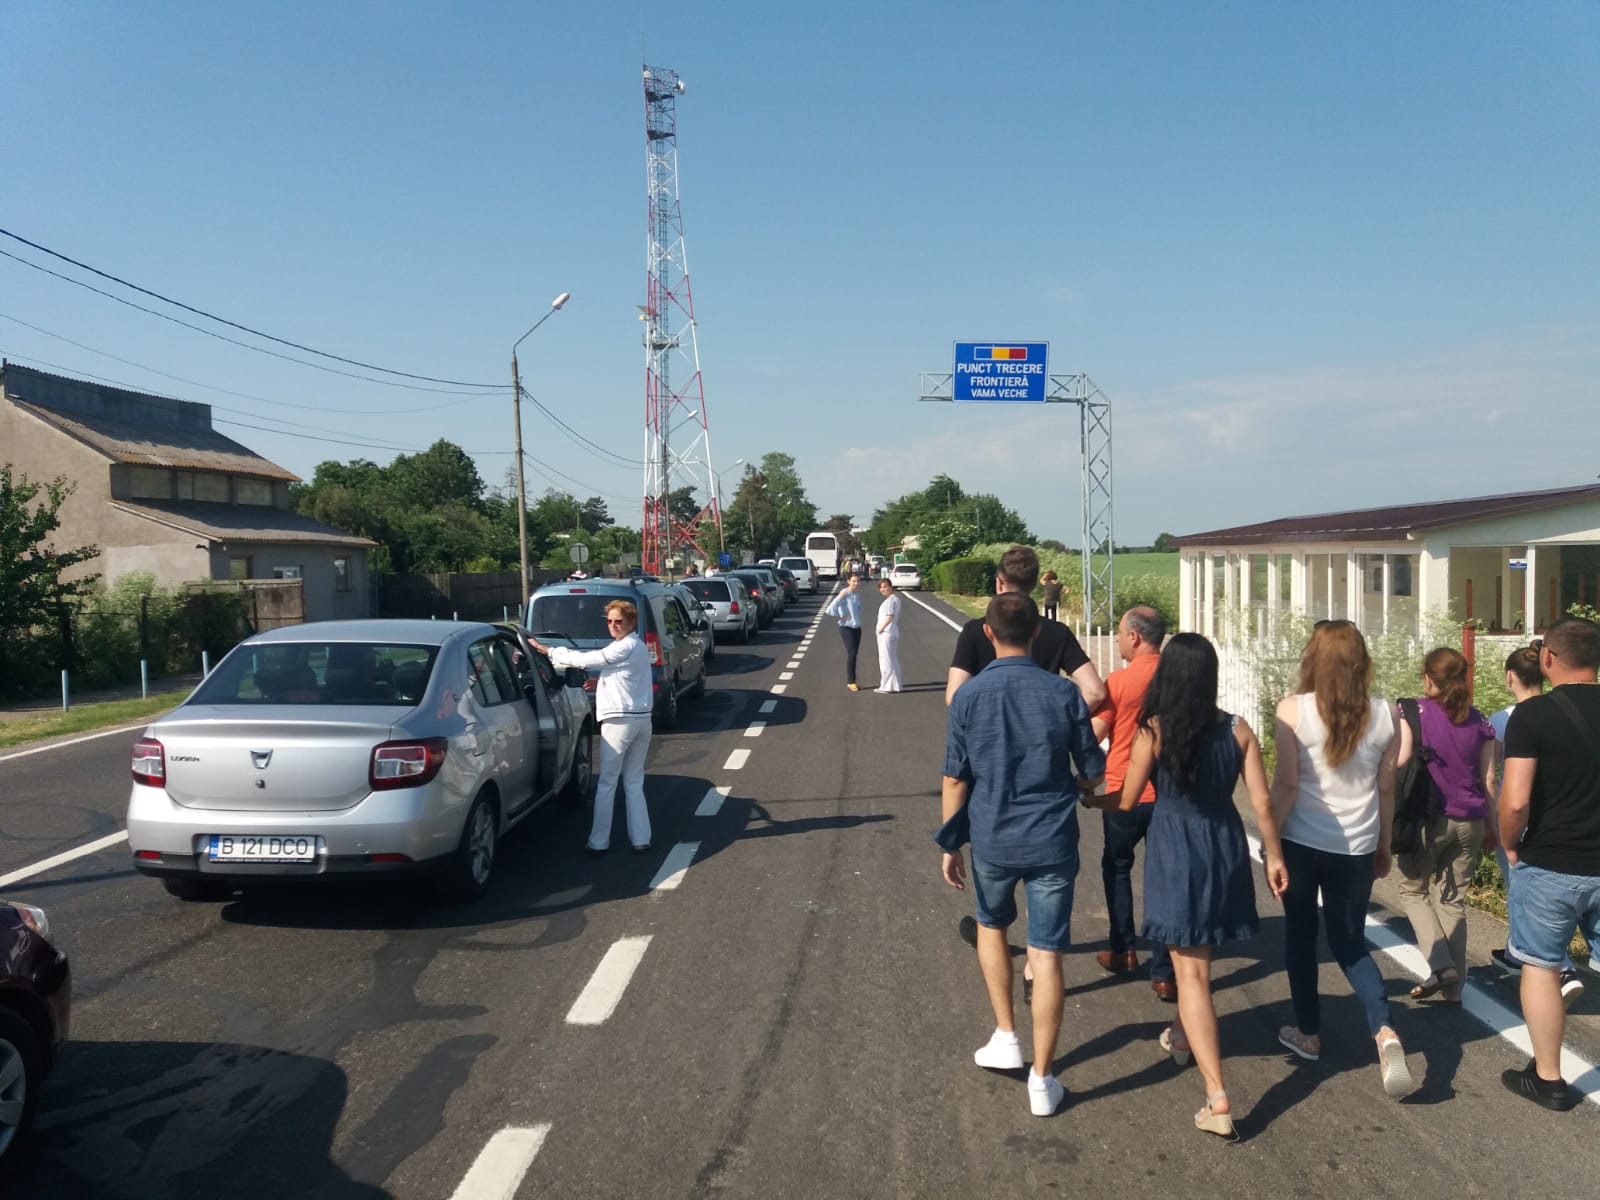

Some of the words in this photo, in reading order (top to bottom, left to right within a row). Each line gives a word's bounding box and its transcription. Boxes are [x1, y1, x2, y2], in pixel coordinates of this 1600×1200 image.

[957, 363, 992, 374] PUNCT
[995, 363, 1044, 374] TRECERE
[971, 388, 996, 398] VAMA
[998, 388, 1029, 398] VECHE
[222, 837, 234, 855] B
[240, 837, 263, 855] 121
[269, 838, 308, 855] DCO
